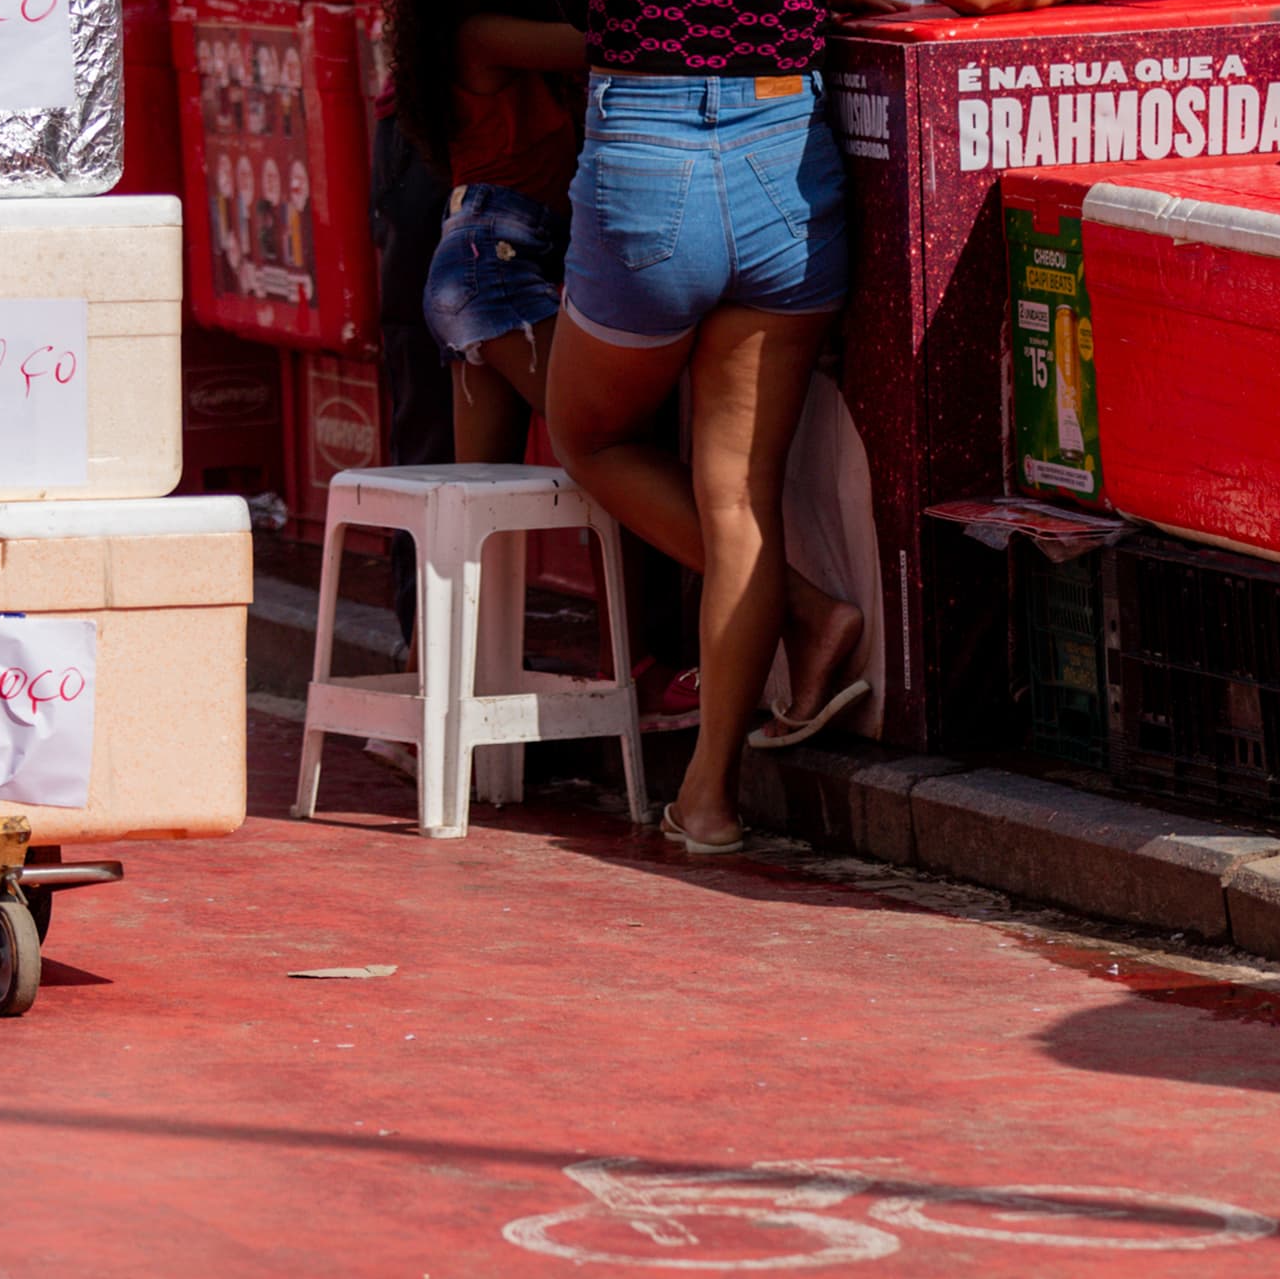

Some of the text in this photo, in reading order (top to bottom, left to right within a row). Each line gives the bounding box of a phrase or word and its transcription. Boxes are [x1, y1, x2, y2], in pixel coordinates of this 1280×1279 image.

[958, 54, 1246, 92] É NA RUA QUE A
[1033, 247, 1067, 269] CHEGOU
